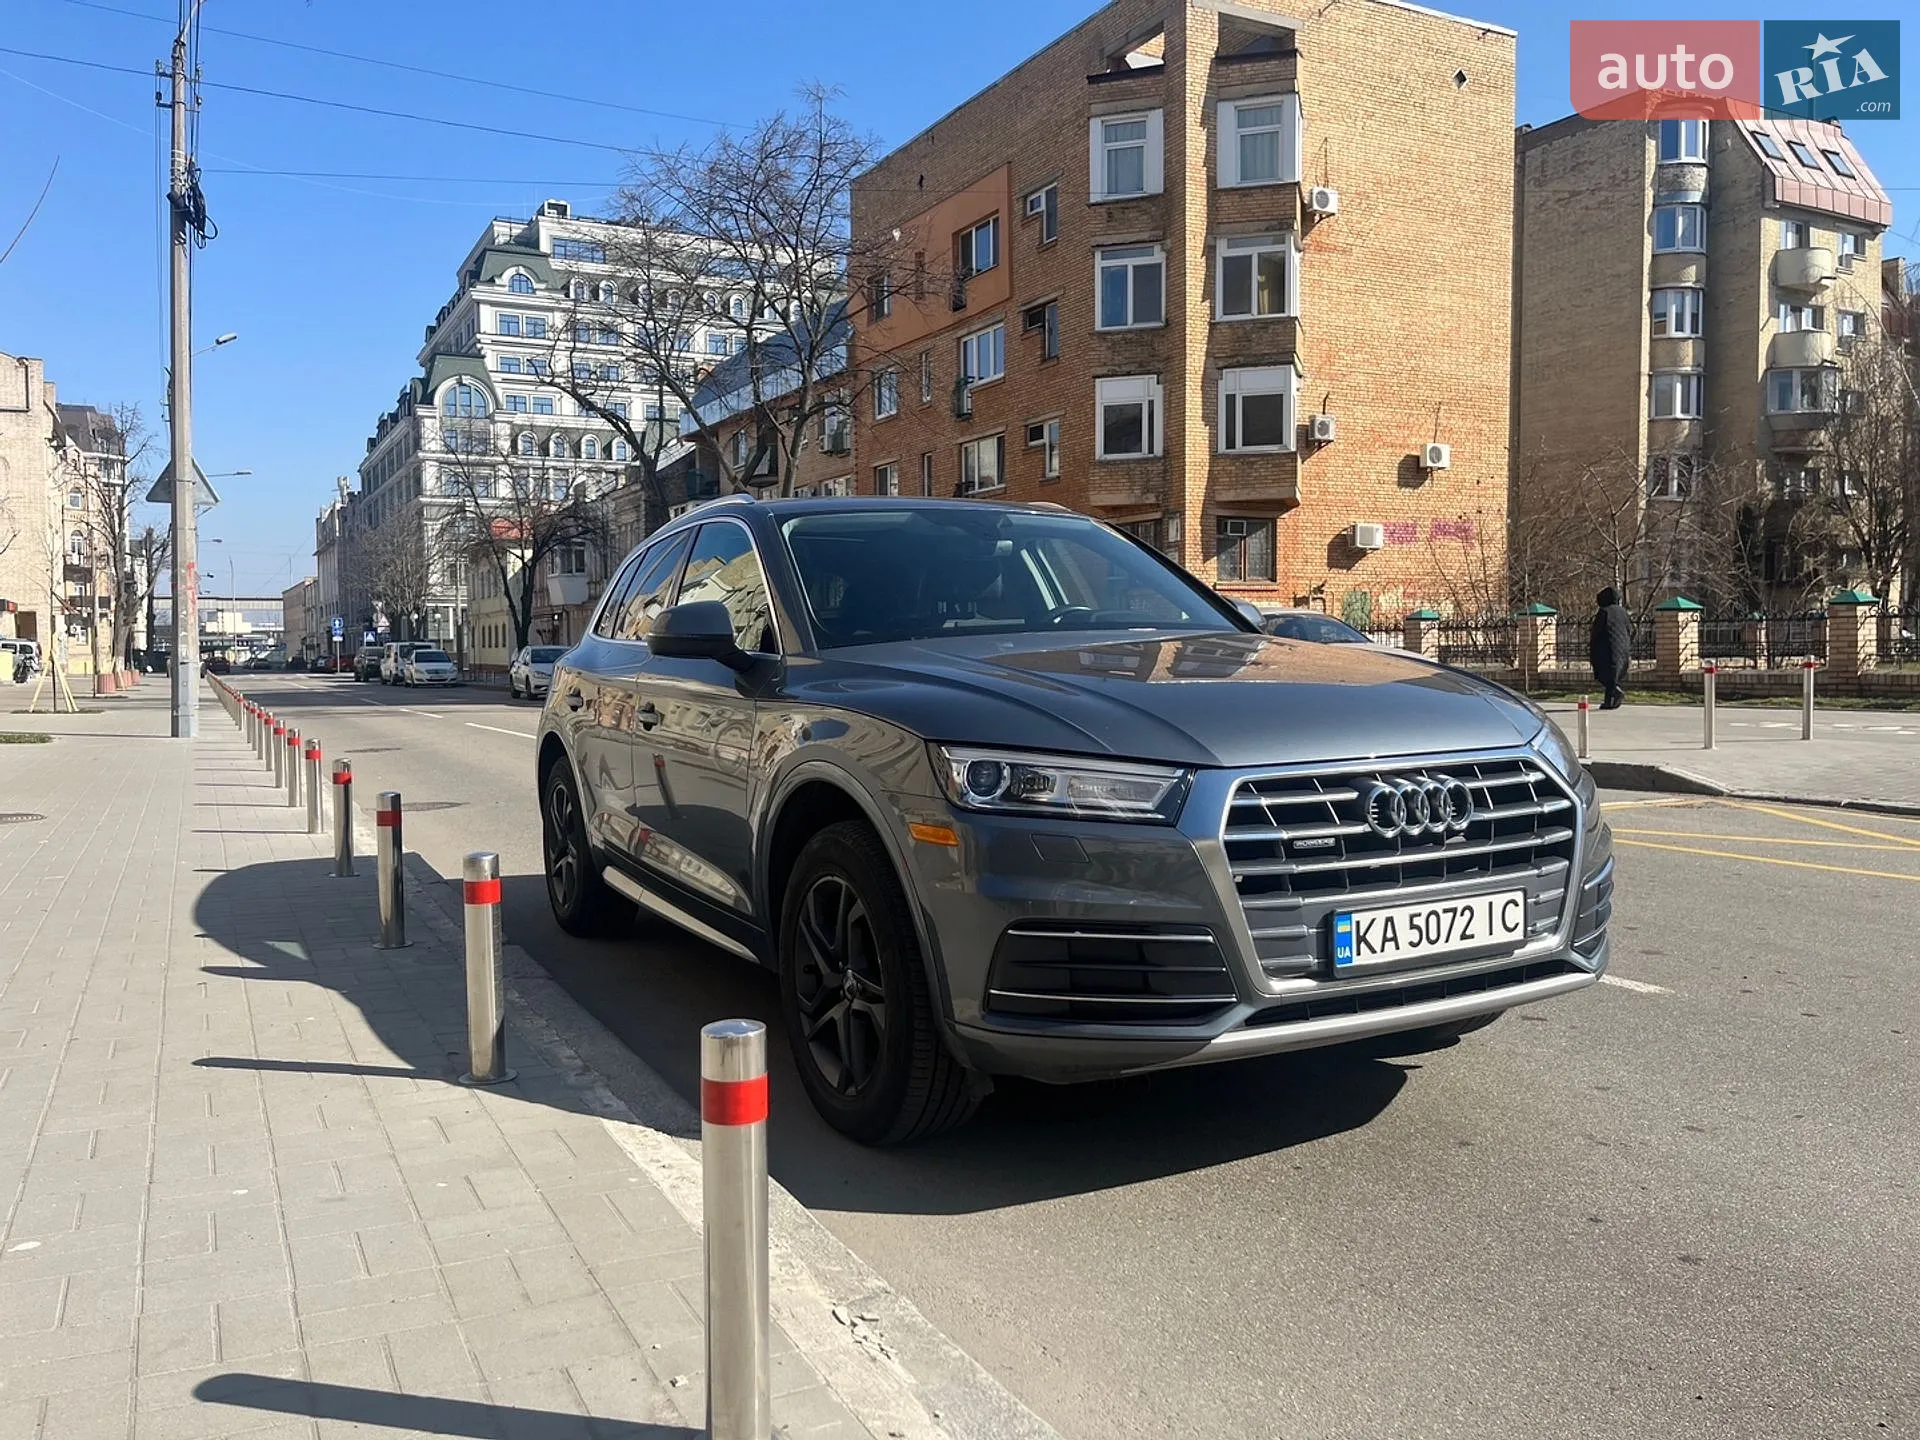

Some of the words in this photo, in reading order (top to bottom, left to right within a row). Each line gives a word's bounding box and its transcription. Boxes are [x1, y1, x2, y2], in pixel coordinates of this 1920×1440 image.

[1355, 916, 1401, 957] KA
[1408, 905, 1475, 949] 5072
[1337, 946, 1352, 959] UA
